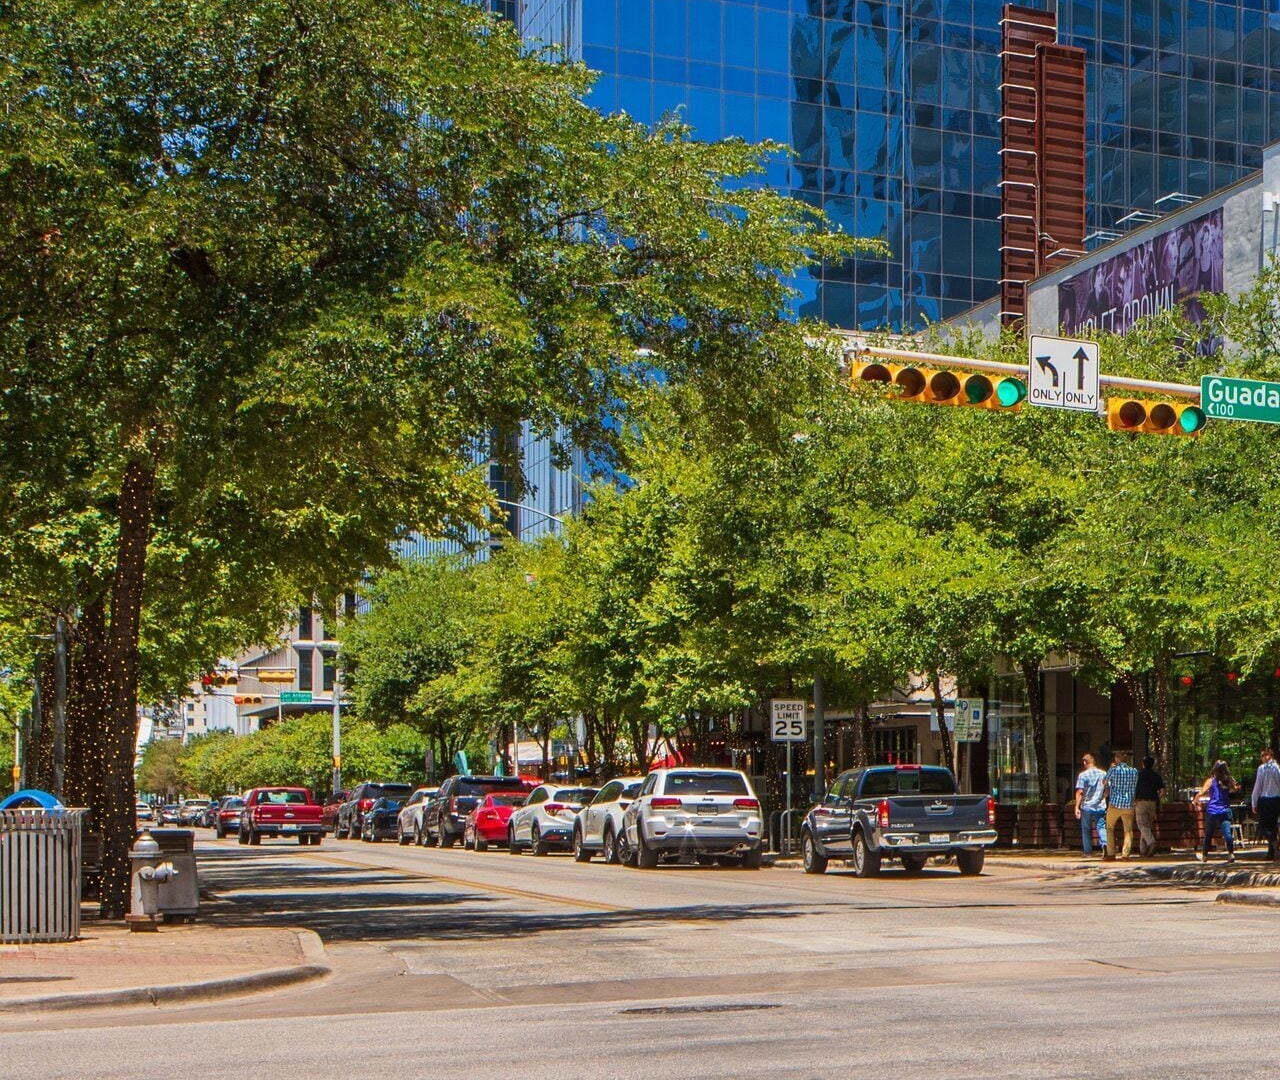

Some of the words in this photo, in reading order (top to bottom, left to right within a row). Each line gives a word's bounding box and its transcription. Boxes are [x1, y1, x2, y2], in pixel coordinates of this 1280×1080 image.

[1033, 388, 1062, 401] ONLY
[1065, 392, 1094, 405] ONLY
[1215, 404, 1234, 416] 100
[774, 703, 804, 711] SPEED
[777, 712, 800, 720] LIMIT
[775, 721, 803, 736] 25
